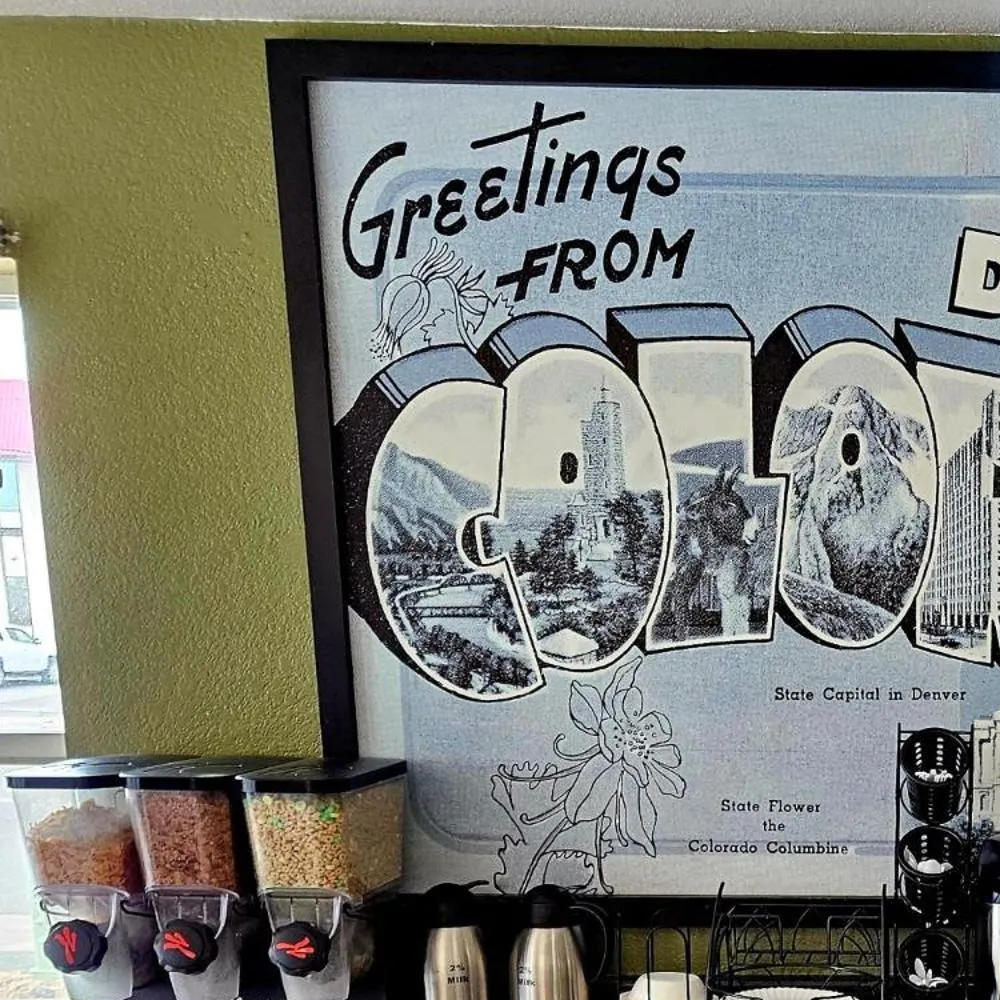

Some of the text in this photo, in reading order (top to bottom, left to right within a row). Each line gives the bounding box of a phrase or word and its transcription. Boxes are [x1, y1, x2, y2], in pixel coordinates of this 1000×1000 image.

[343, 101, 687, 280] Greetings
[495, 228, 695, 301] FROM
[774, 687, 967, 702] State Capital in Denver
[720, 799, 821, 812] State Flower
[762, 820, 786, 832] the
[688, 839, 849, 855] Colorado Columbine
